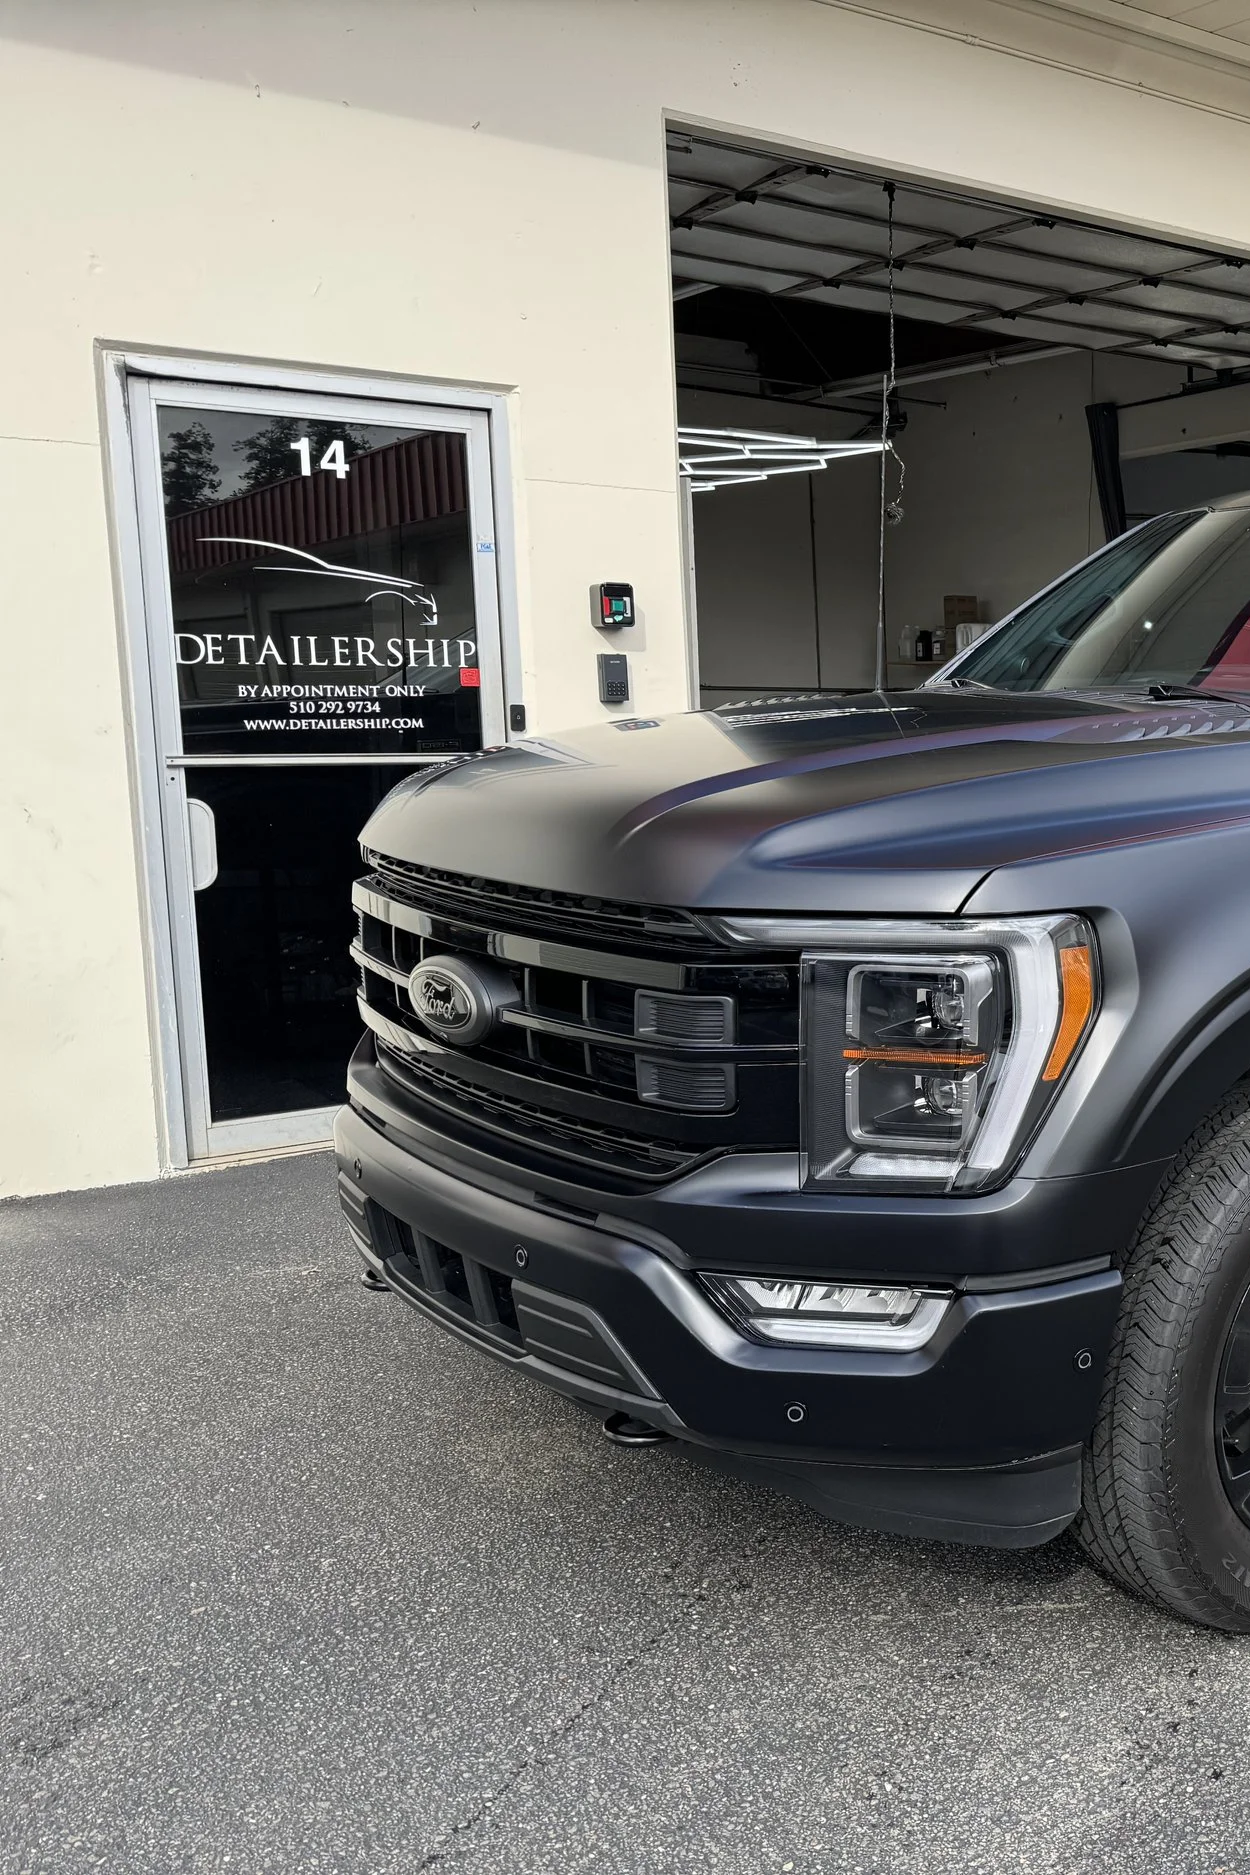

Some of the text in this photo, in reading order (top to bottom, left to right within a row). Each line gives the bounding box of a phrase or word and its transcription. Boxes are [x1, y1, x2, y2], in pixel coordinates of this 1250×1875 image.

[289, 436, 351, 479] 14
[174, 633, 477, 668] DETAILERSHIP
[237, 684, 426, 698] BY APPOINTMENT ONLY
[289, 701, 382, 714] 510 292 9734
[243, 718, 425, 731] WWW.DETAILERSHIP.COM
[420, 978, 456, 1021] Ford
